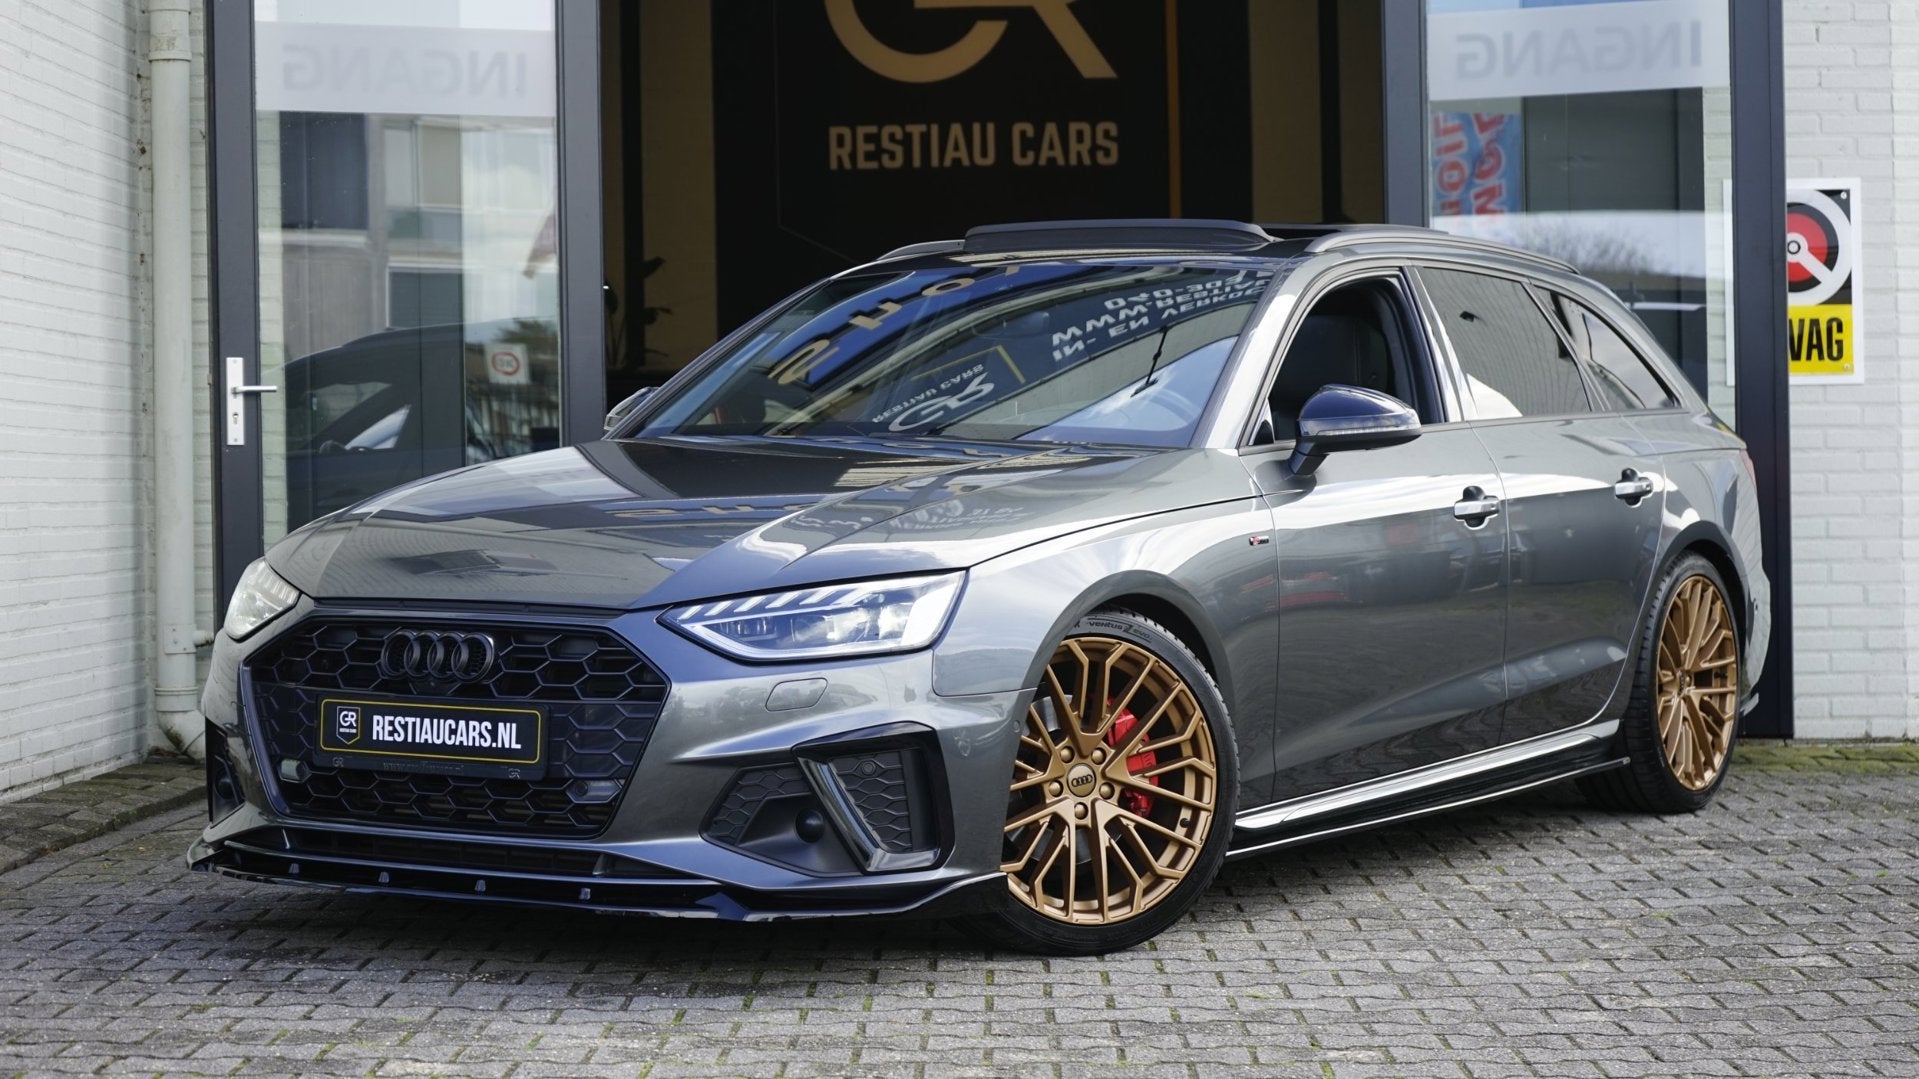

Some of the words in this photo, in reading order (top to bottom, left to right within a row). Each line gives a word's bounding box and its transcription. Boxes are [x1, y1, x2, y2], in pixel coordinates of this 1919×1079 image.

[829, 122, 995, 170] RESTIAU
[1011, 121, 1119, 166] CARS
[1788, 317, 1844, 361] VAG
[372, 714, 522, 749] RESTIAUCARS.NL
